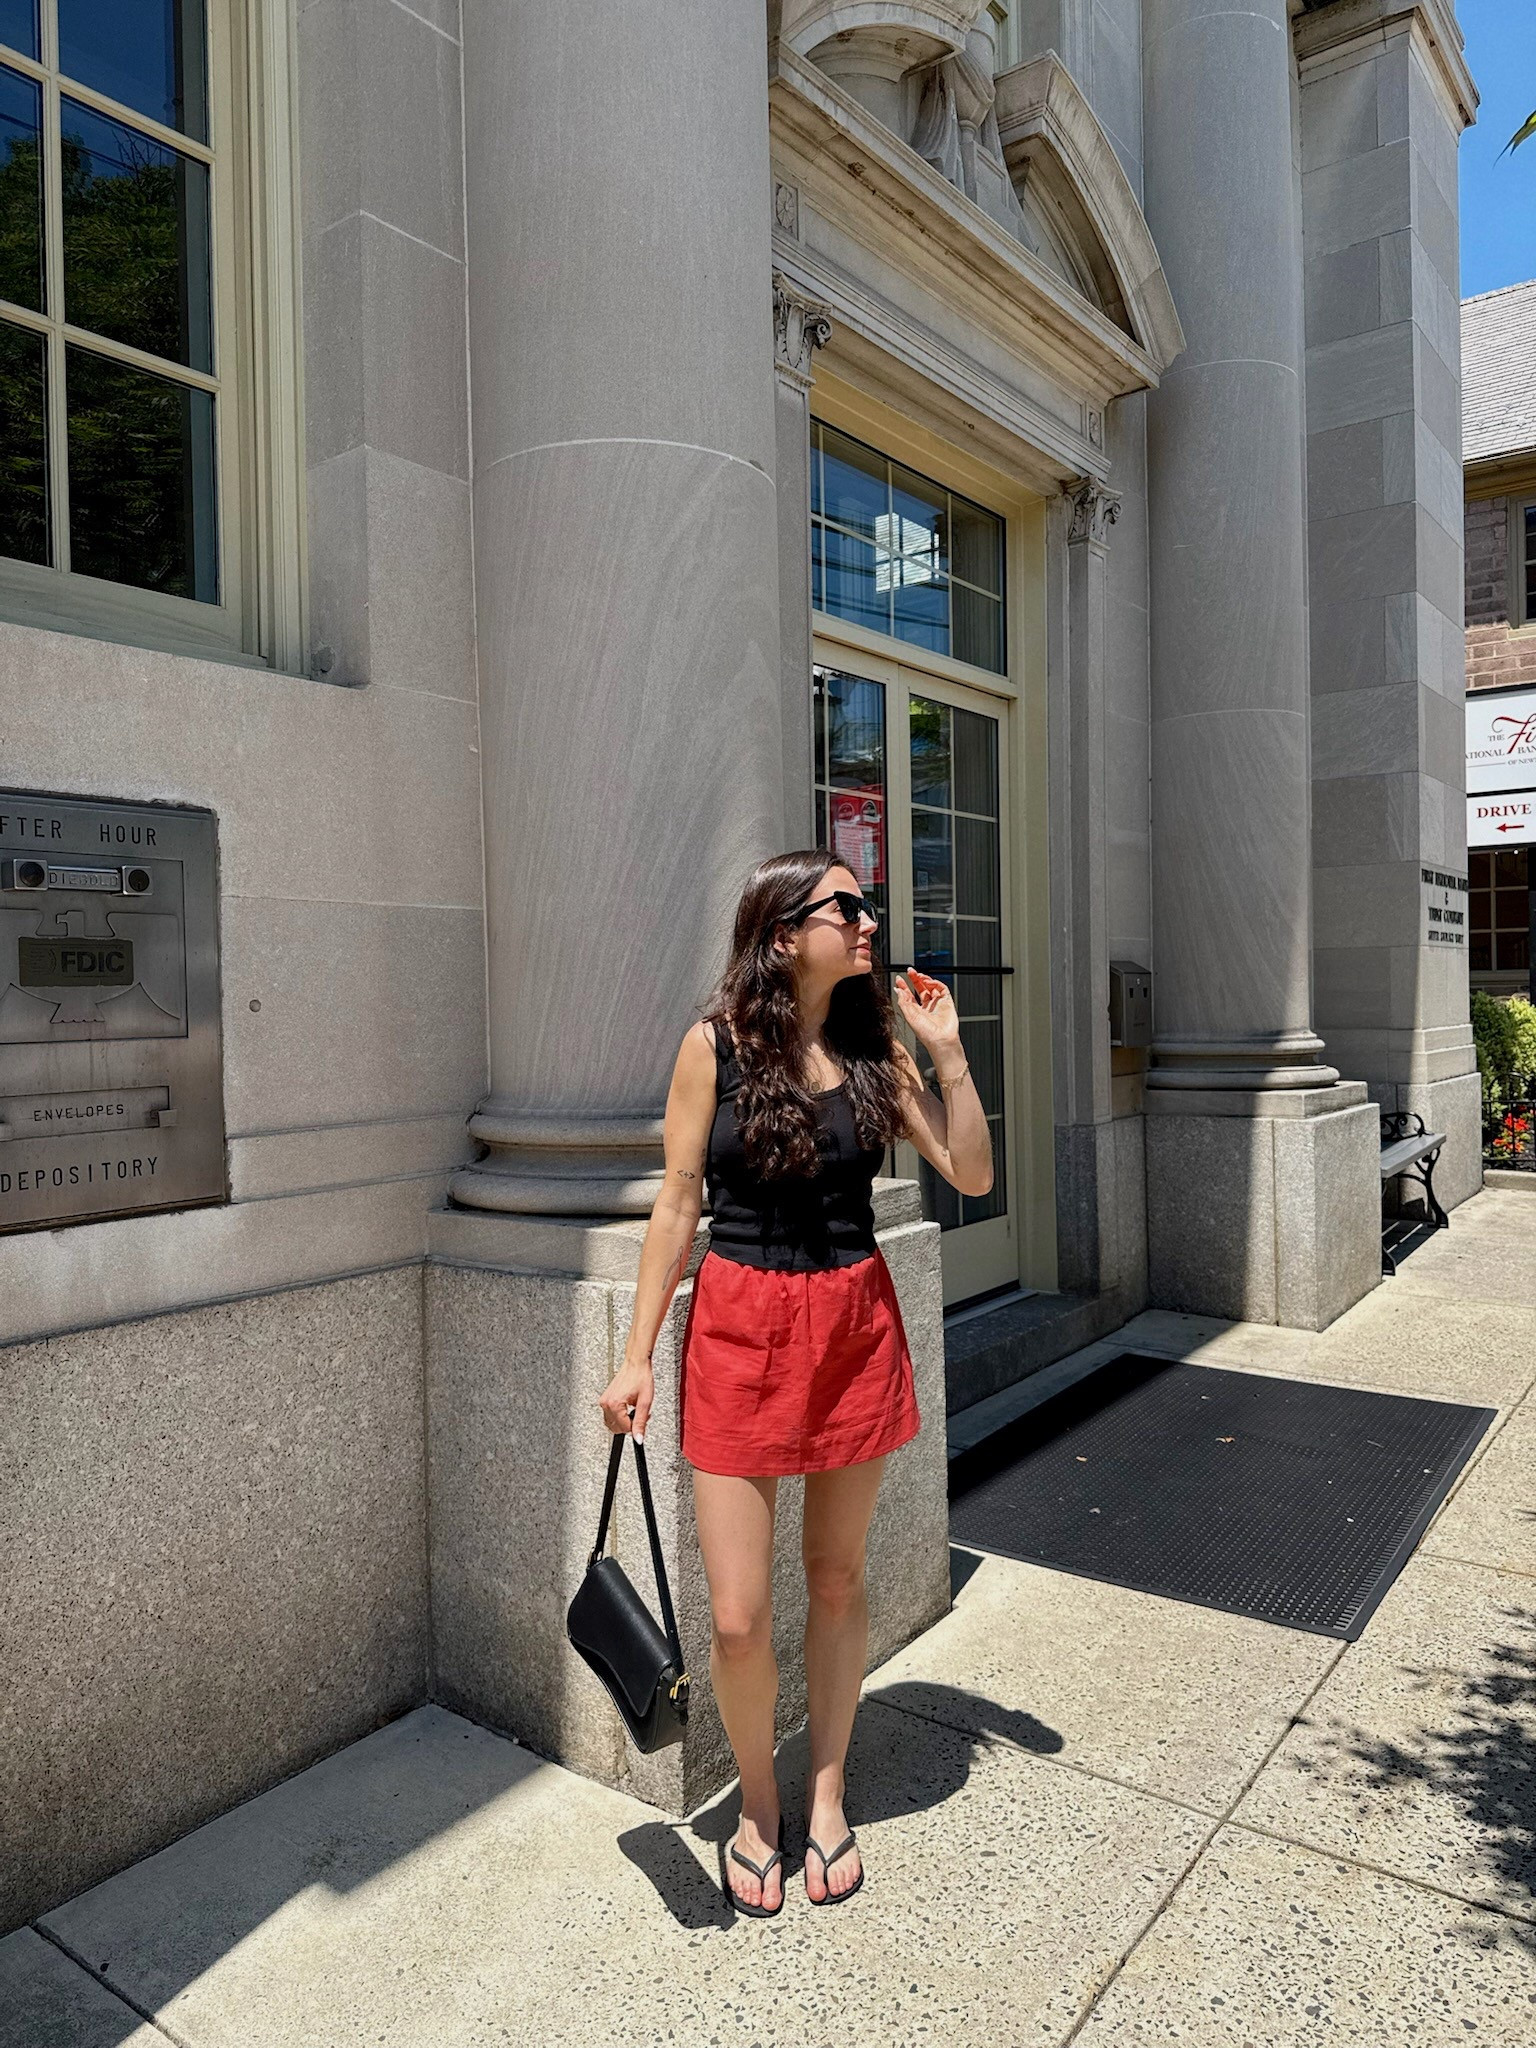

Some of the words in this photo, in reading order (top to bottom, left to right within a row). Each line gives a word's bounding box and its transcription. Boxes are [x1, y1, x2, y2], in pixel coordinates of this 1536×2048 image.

[1487, 734, 1505, 742] THE
[1476, 803, 1532, 818] DRIVE
[0, 815, 62, 839] FTER
[100, 823, 157, 846] HOUR
[49, 872, 118, 886] DIEBOLD
[61, 951, 125, 973] FDIC
[34, 1104, 124, 1121] ENVELOPES
[1, 1156, 157, 1192] DEPOSITORY
